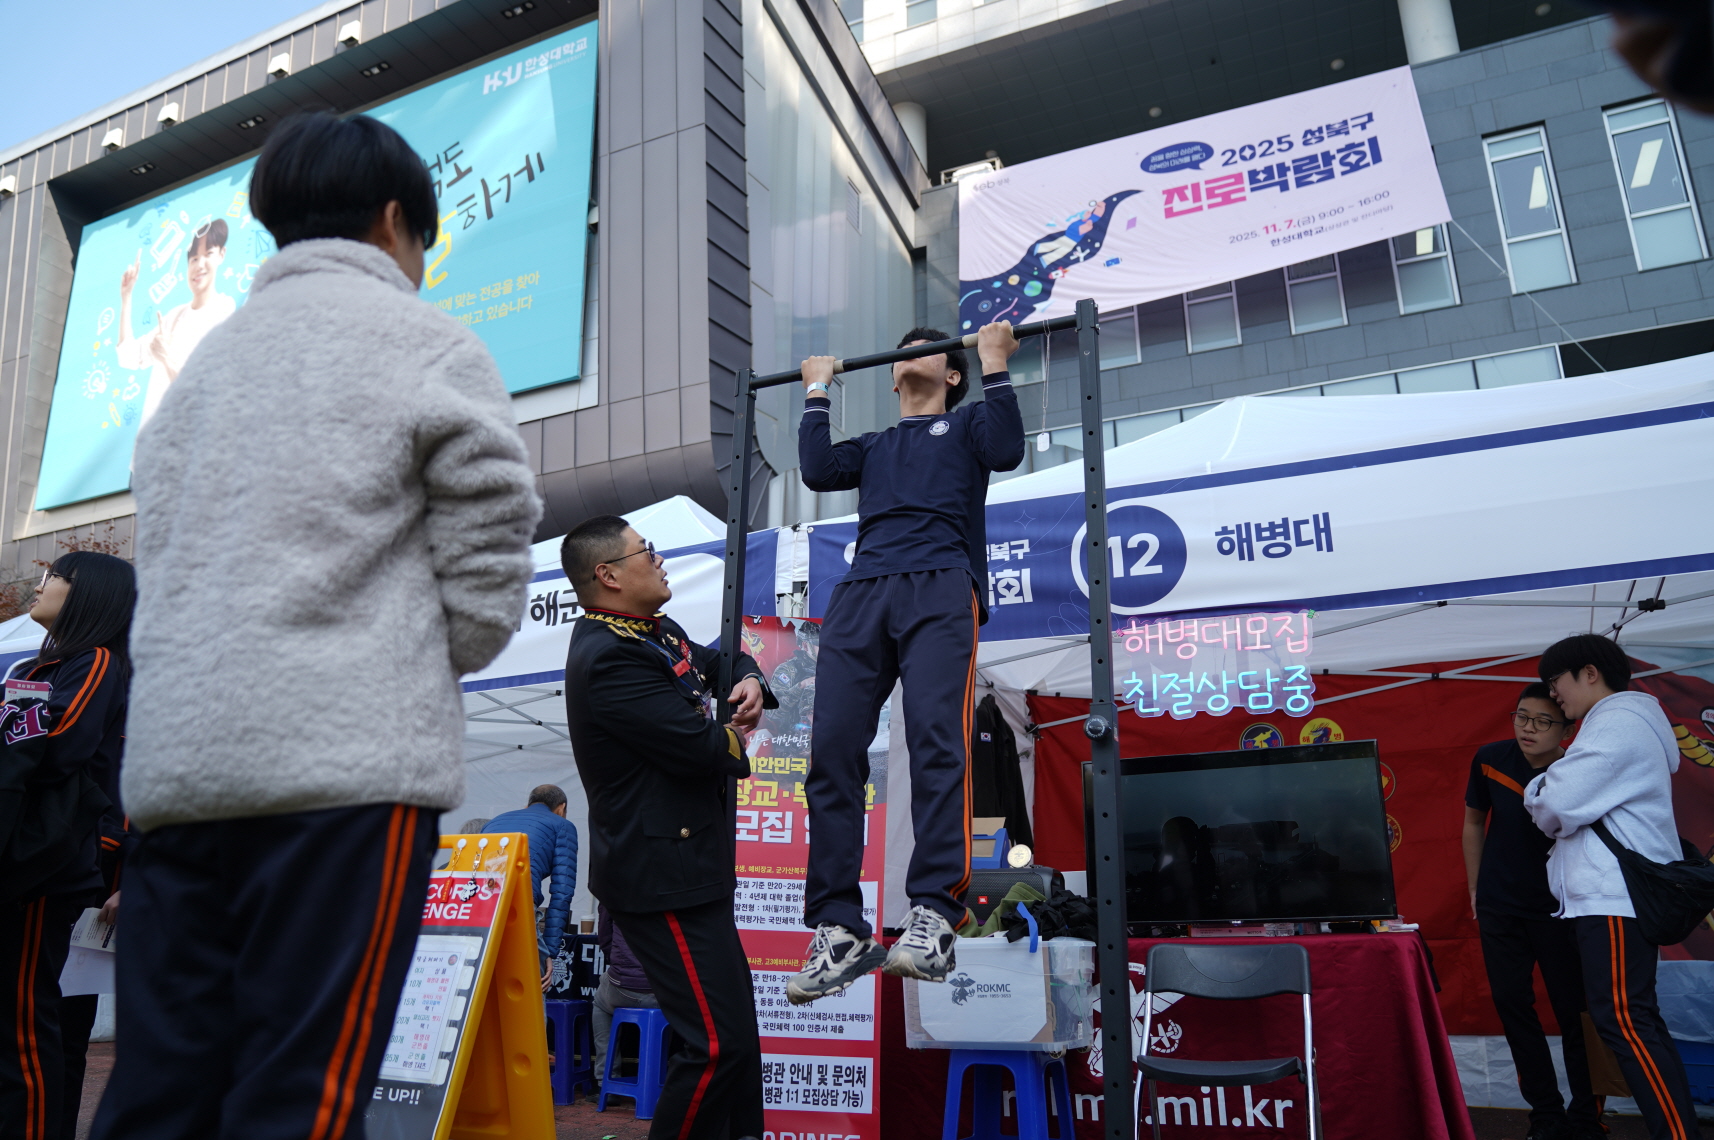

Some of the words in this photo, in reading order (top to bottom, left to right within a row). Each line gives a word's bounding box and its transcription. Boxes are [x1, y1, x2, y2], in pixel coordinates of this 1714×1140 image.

[525, 37, 587, 72] 한성대학교
[1221, 134, 1294, 167] 2025
[1302, 111, 1375, 146] 성북구
[1161, 135, 1383, 220] 진로박람회
[1229, 230, 1260, 244] 2025.
[1318, 206, 1345, 220] 9:00
[1358, 190, 1390, 207] 16:00
[455, 291, 477, 309] 맞는
[480, 279, 514, 301] 전공을
[516, 270, 541, 291] 찾아
[486, 294, 534, 321] 있습니다
[1214, 512, 1334, 562] 해병대
[1107, 532, 1163, 579] 12
[1123, 614, 1309, 660] 해병대모집
[1123, 665, 1311, 715] 친절상담중
[750, 734, 769, 746] 나는
[736, 810, 793, 844] 모집
[749, 892, 767, 901] 4년제
[769, 893, 783, 901] 대학
[752, 881, 765, 889] 기준
[768, 916, 795, 925] 국민체력
[767, 986, 780, 995] 기준
[976, 983, 1011, 993] ROKMC
[762, 1021, 790, 1032] 국민체력
[793, 1024, 805, 1032] 100
[807, 1023, 828, 1033] 인증서
[830, 1025, 844, 1034] 제출
[790, 1063, 813, 1086] 안내
[817, 1064, 828, 1086] 및
[832, 1065, 867, 1088] 문의처
[388, 1087, 421, 1105] UP!!
[764, 1086, 783, 1104] 병관
[785, 1088, 799, 1103] 1:1
[801, 1088, 839, 1107] 모집상담
[842, 1090, 864, 1108] 가능)
